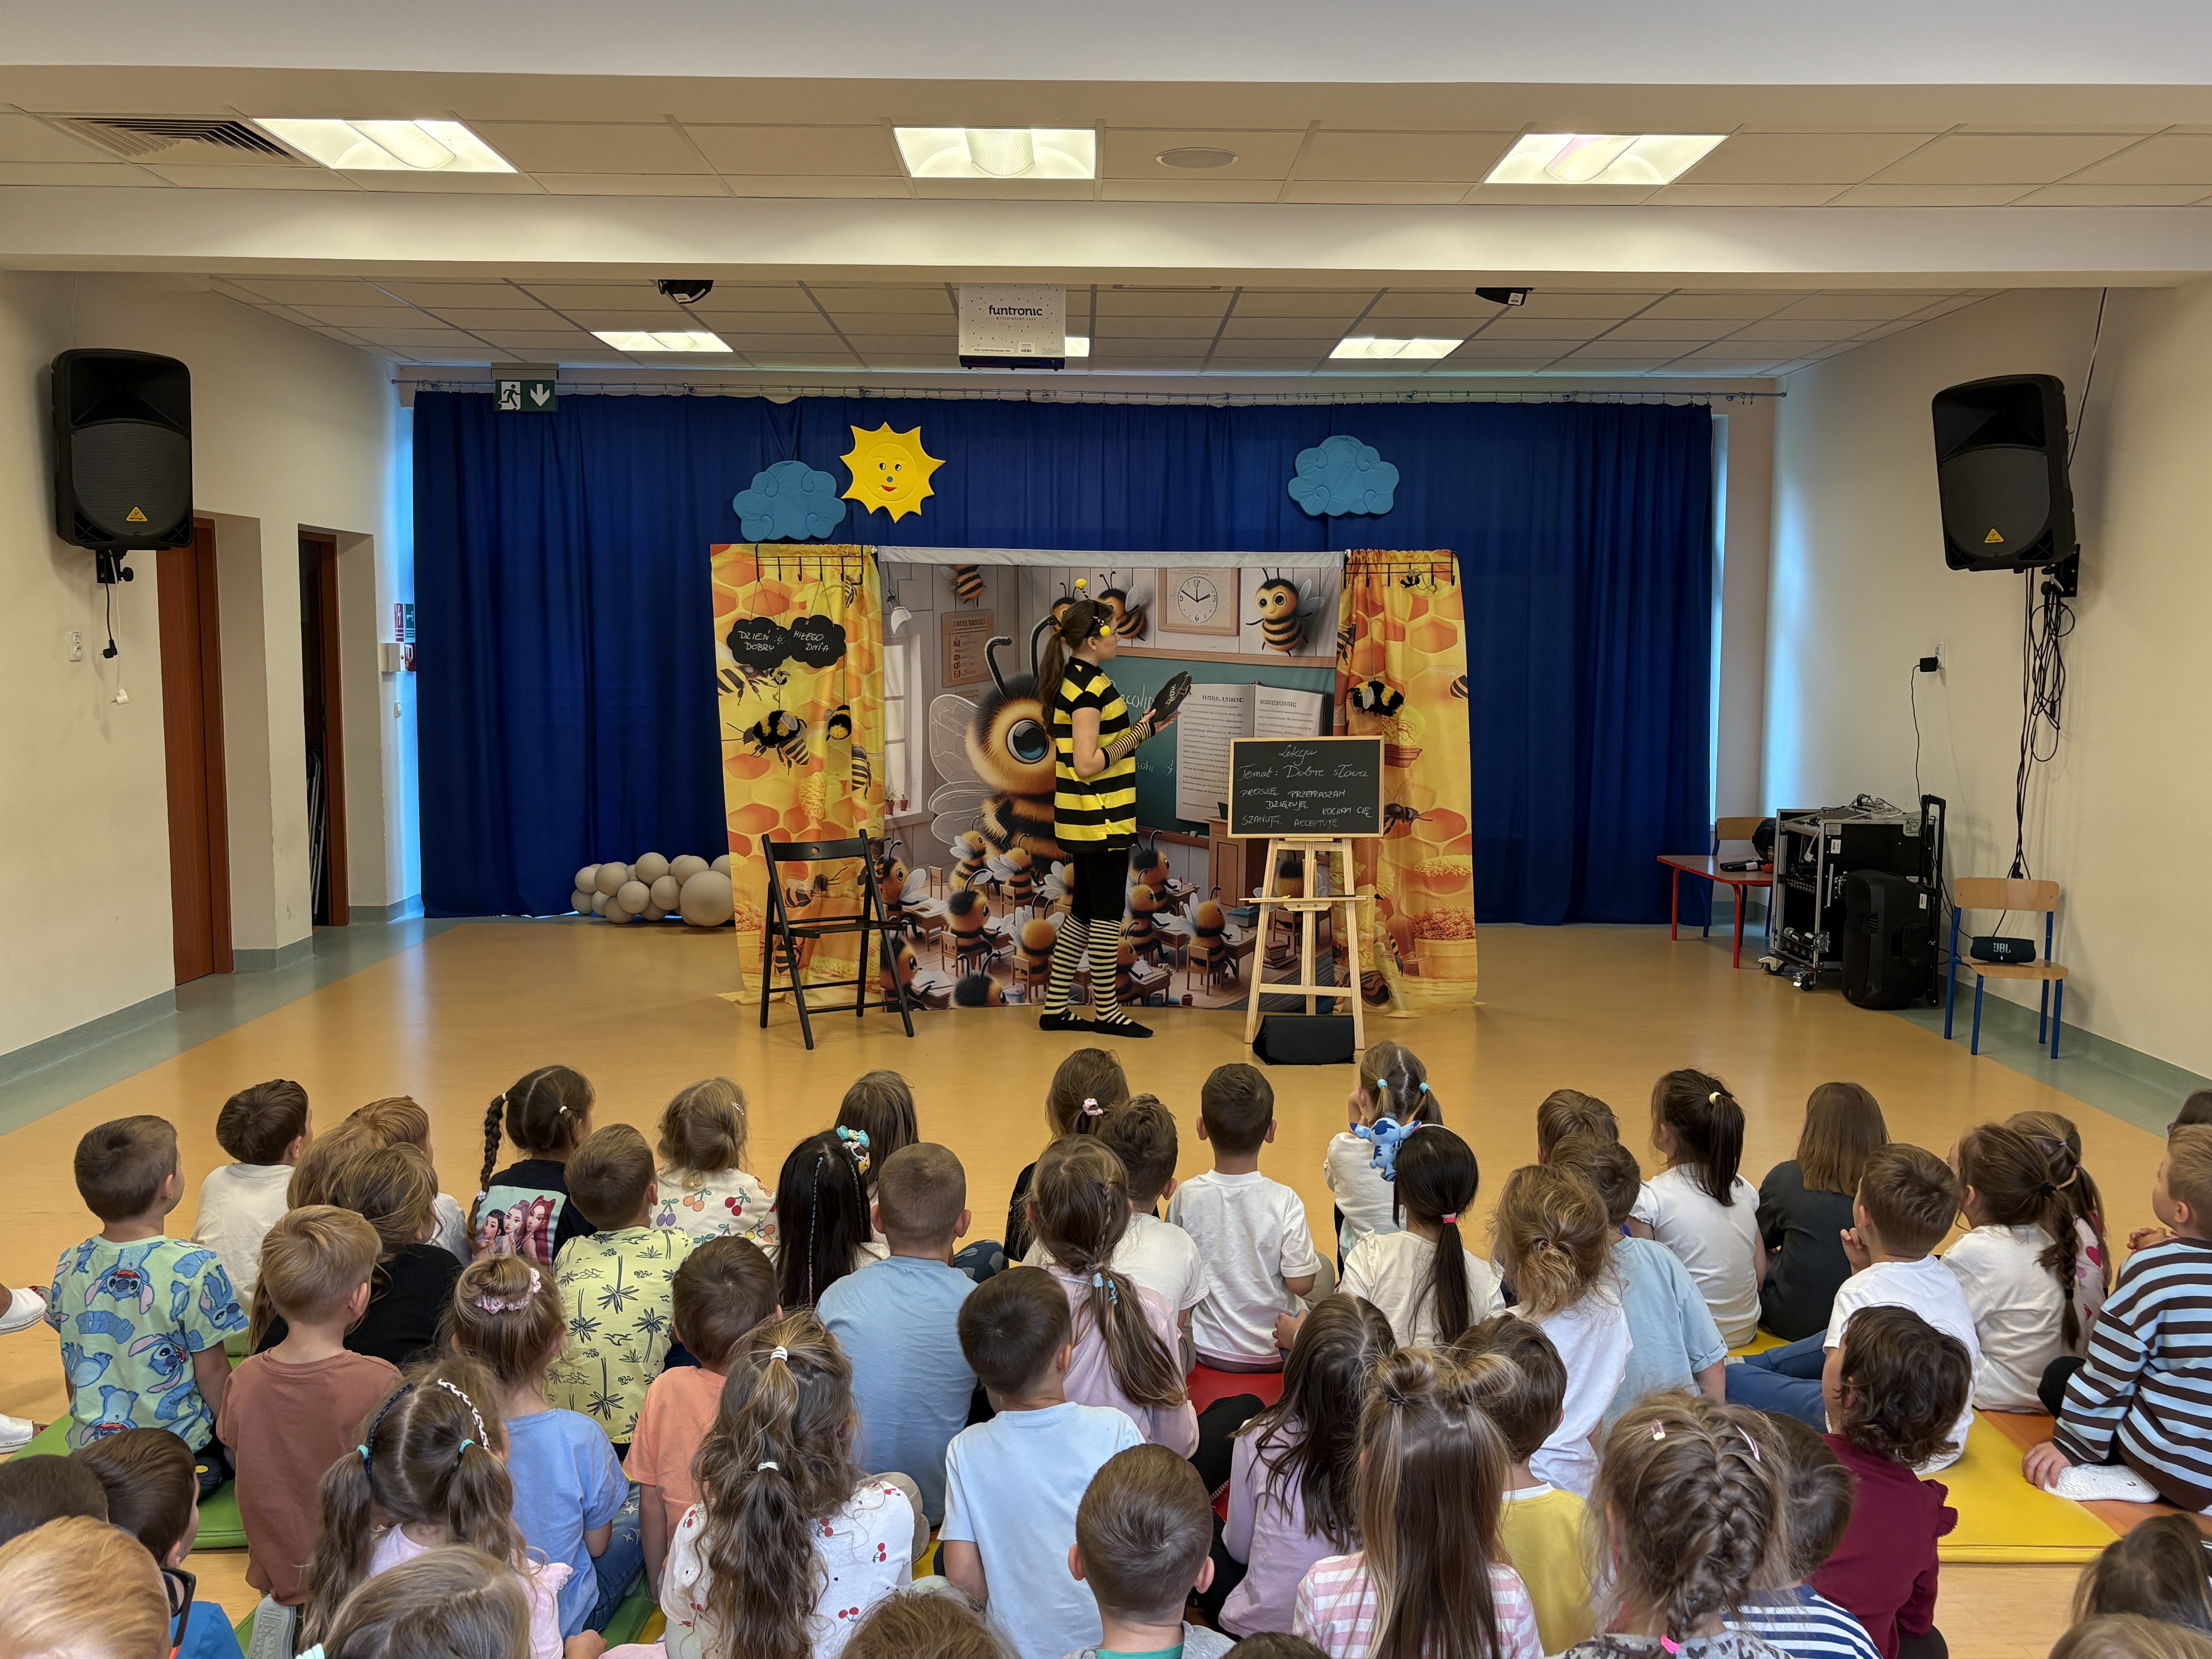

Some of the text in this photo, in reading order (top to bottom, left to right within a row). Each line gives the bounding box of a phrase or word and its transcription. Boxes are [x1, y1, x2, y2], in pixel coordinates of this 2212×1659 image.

[989, 305, 1042, 316] funtronic
[738, 630, 770, 640] DZIEŃ
[744, 642, 775, 652] DOBRY
[1278, 744, 1318, 766] Lekcja
[1283, 765, 1324, 778] Dobre
[1240, 787, 1346, 799] PROSZĘ PRZEPRASZAM
[1265, 801, 1309, 811] DZIĘKUJĘ
[1357, 807, 1372, 817] CIĘ
[1241, 815, 1339, 830] SZANUJĘ AKCEPTUJĘ
[1993, 943, 2011, 953] JBL
